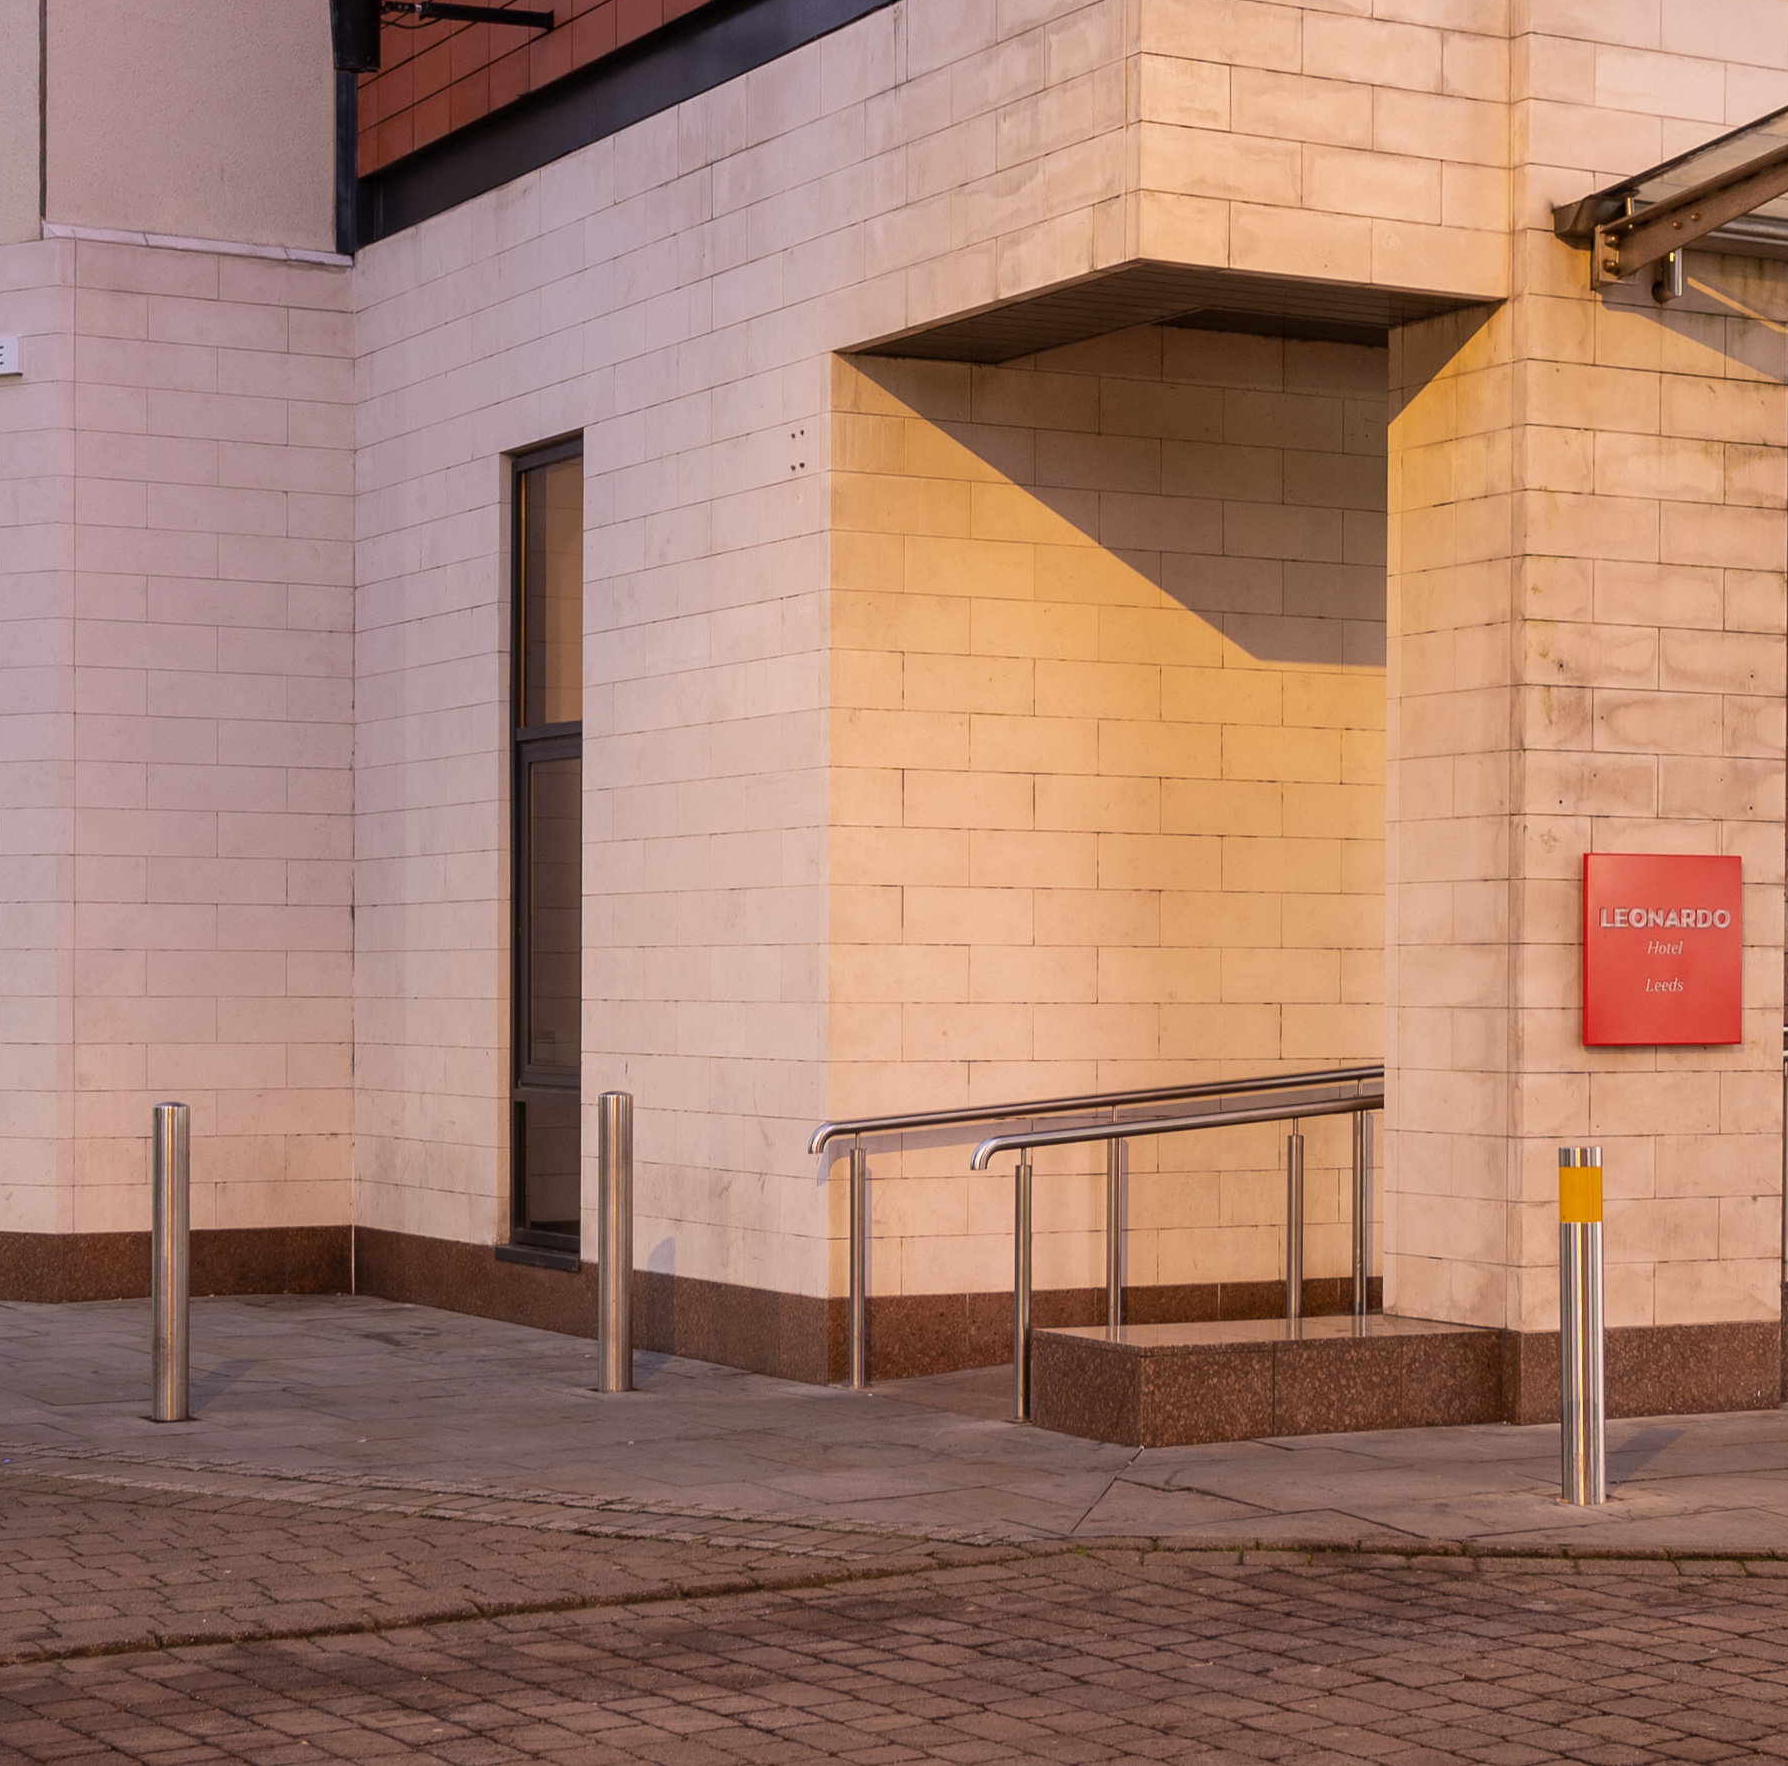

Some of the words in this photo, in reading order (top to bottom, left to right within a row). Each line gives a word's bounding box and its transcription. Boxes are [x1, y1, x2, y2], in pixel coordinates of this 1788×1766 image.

[1599, 907, 1731, 929] LEONARDO
[1647, 940, 1684, 955] Hotel
[1645, 977, 1684, 992] Leeds
